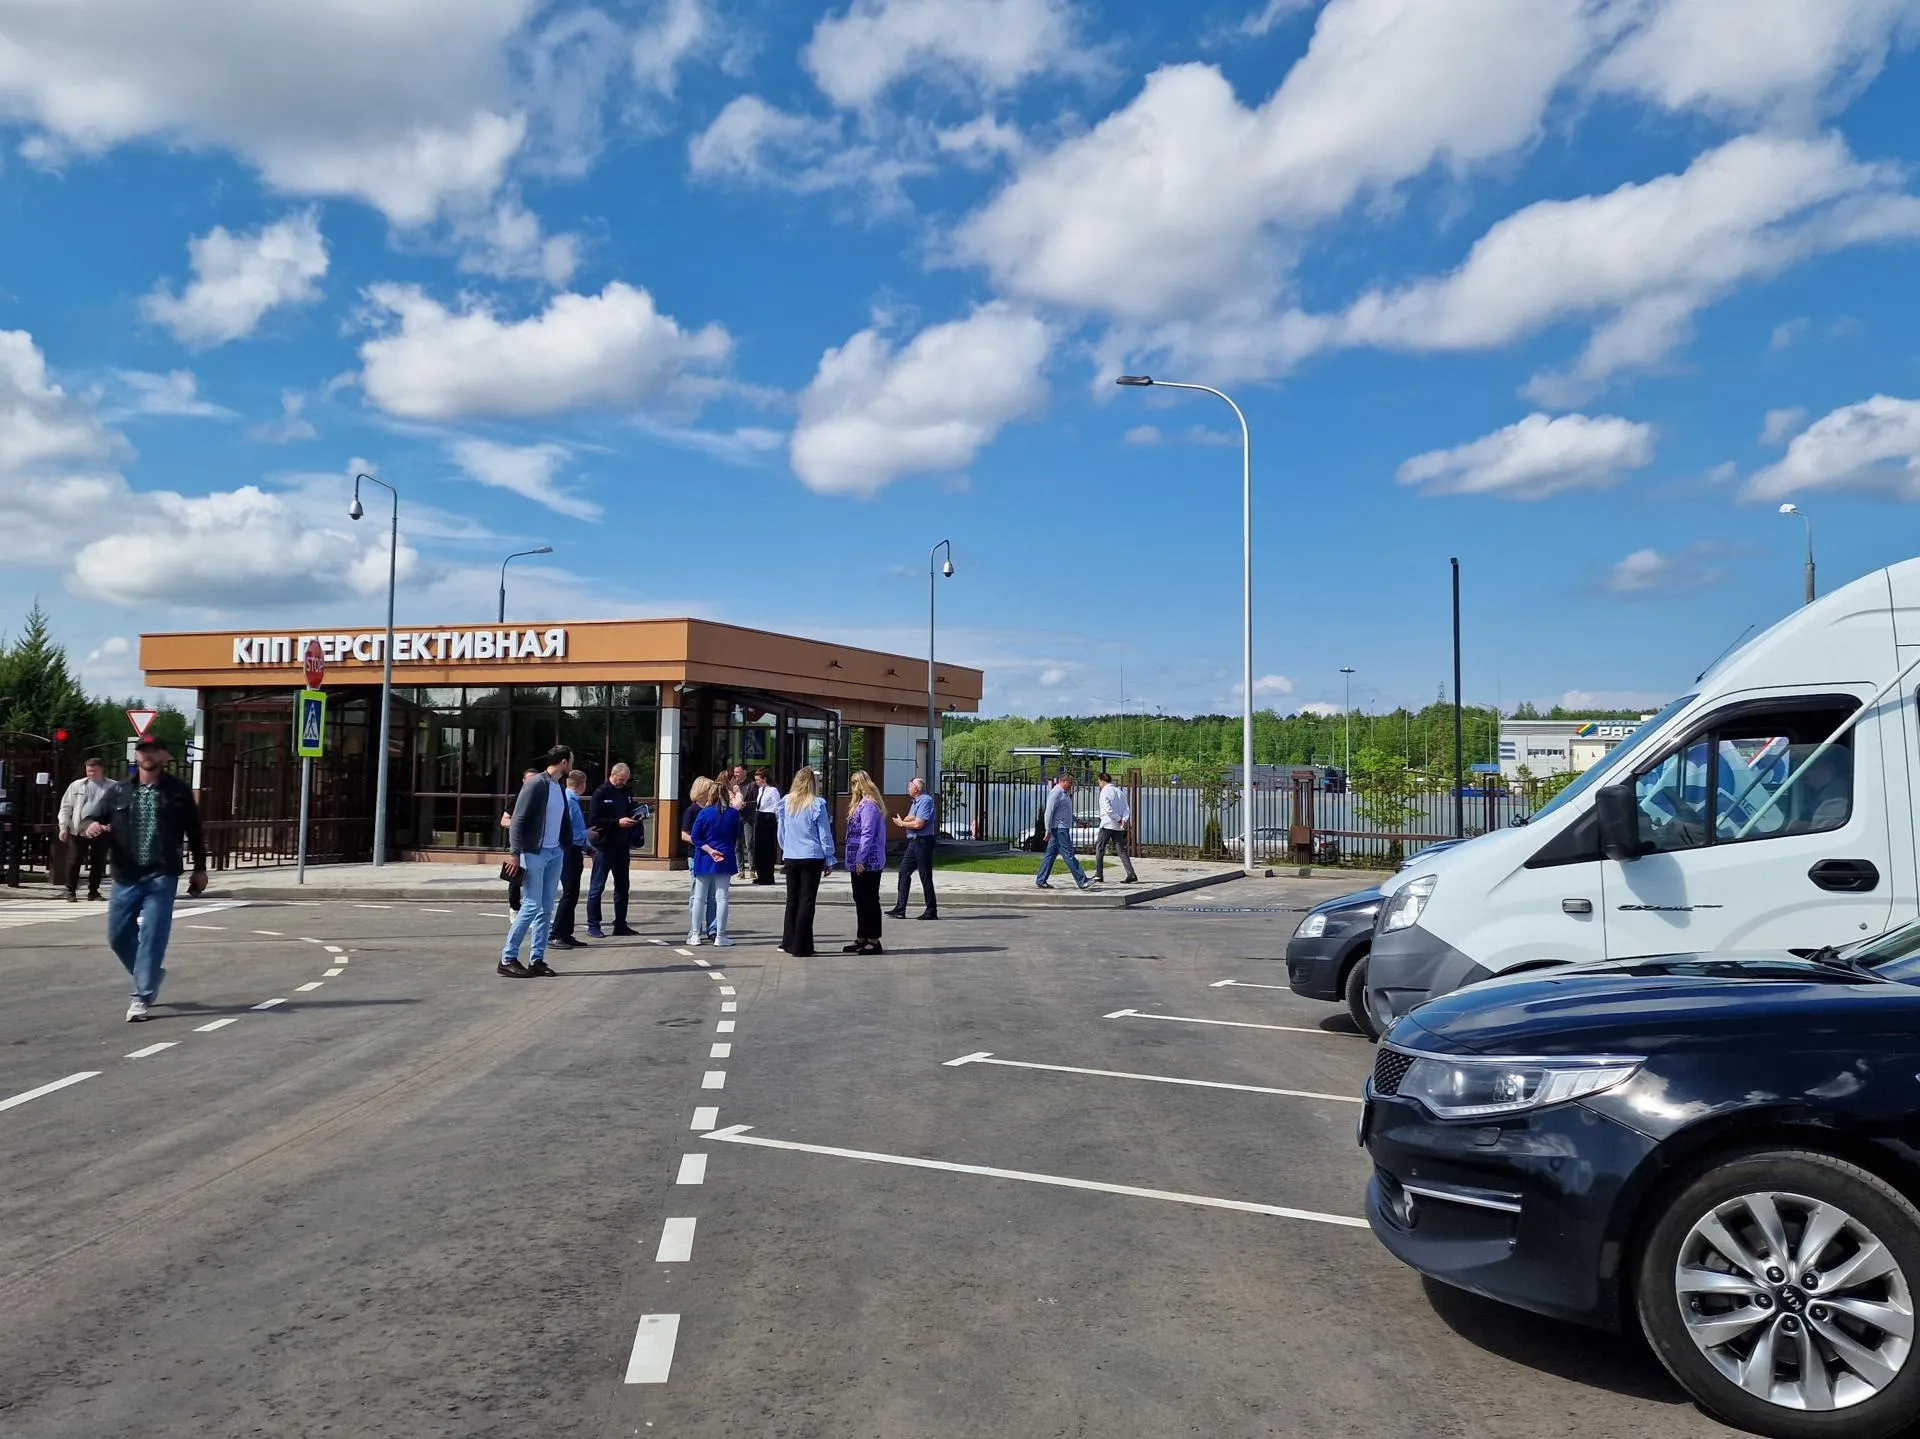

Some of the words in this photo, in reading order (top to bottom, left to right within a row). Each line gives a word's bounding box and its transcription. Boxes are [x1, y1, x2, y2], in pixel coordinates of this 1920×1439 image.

[233, 636, 291, 663] КПП
[306, 656, 324, 672] STOP
[1782, 1288, 1802, 1310] KIA
